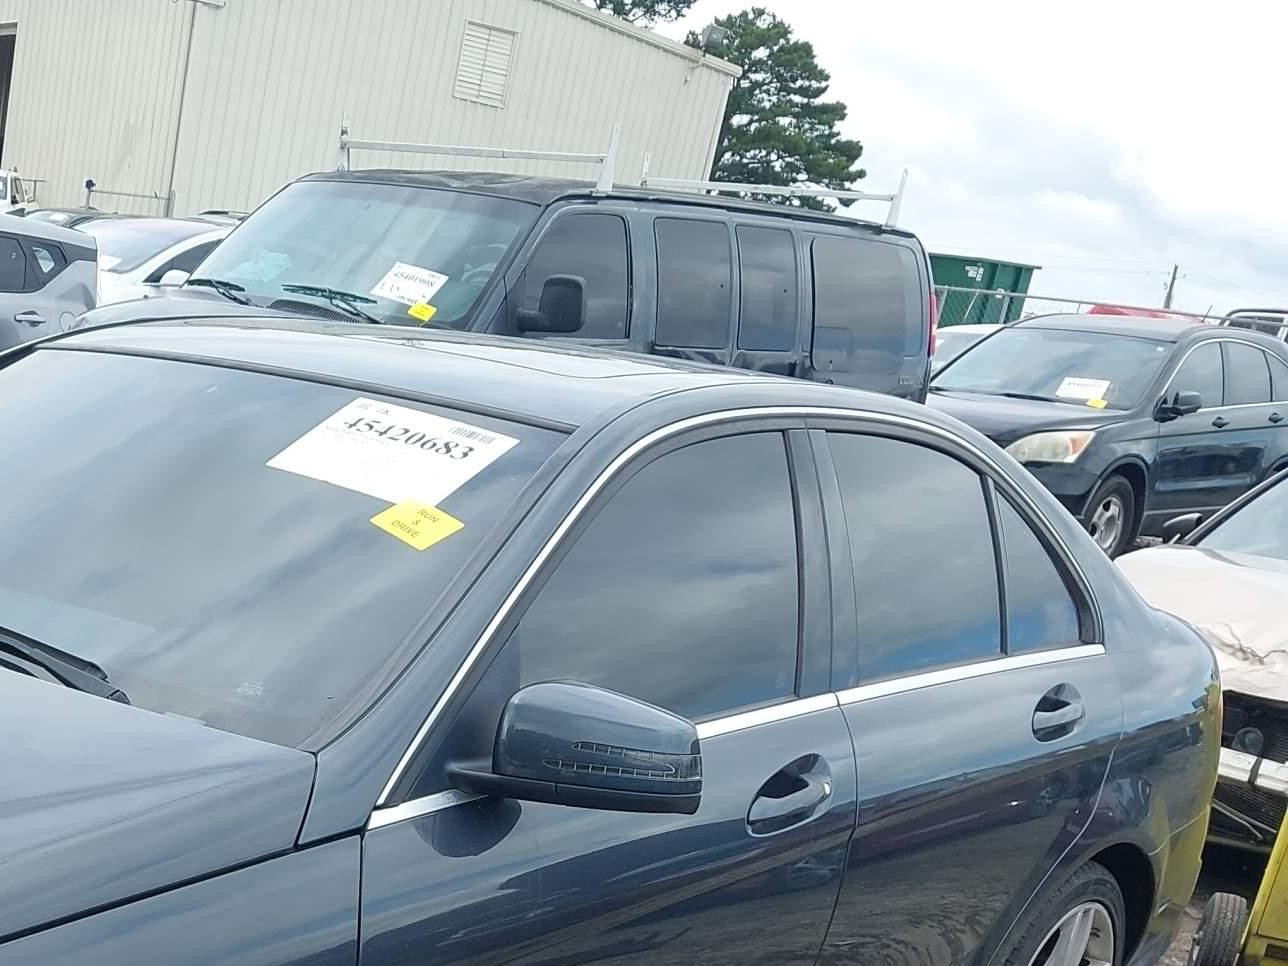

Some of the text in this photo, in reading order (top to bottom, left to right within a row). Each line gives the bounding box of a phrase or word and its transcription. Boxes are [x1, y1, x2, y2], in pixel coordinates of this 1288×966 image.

[343, 417, 475, 460] 45420683
[417, 509, 440, 523] RUN
[391, 519, 421, 538] DRIVE
